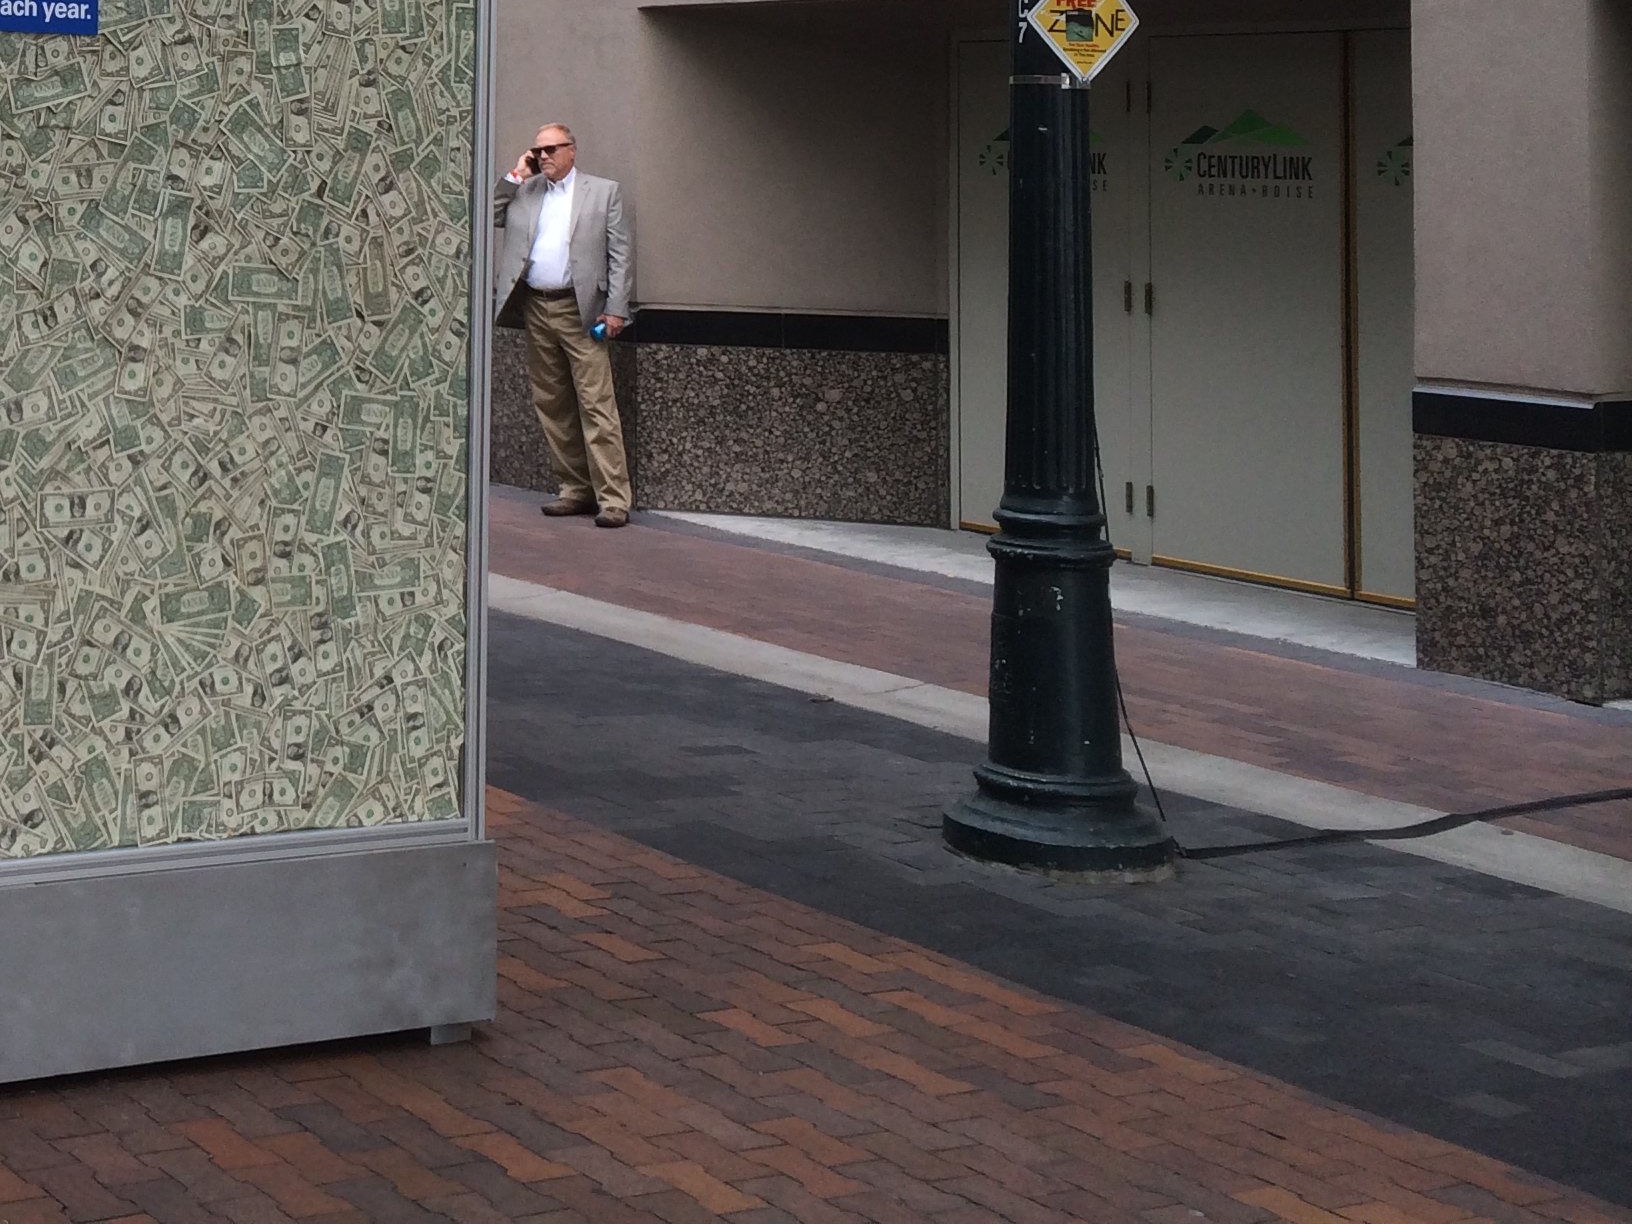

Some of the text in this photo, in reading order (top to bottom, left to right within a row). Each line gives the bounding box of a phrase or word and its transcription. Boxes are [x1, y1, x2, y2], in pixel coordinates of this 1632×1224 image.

[42, 1, 91, 22] year.
[1047, 8, 1126, 38] ZNE
[1197, 183, 1314, 199] ARENA BOISE
